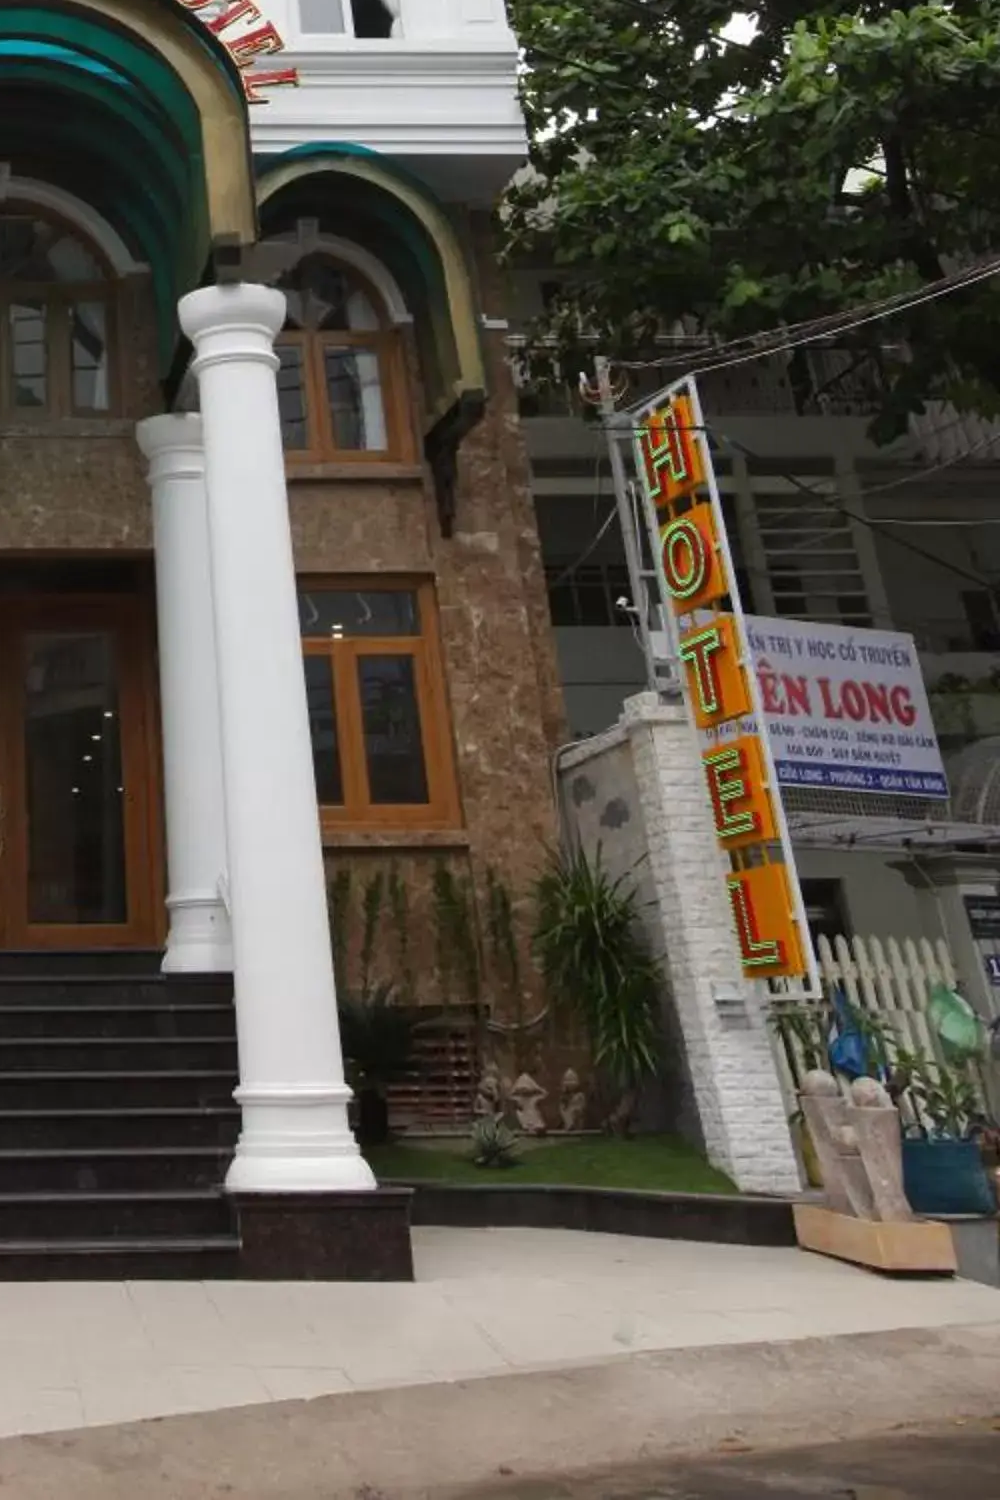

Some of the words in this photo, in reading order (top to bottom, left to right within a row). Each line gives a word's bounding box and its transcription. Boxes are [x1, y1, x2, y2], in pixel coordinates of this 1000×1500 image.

[633, 403, 784, 968] HOTEL
[756, 656, 812, 717] ÊN
[815, 675, 917, 727] LONG
